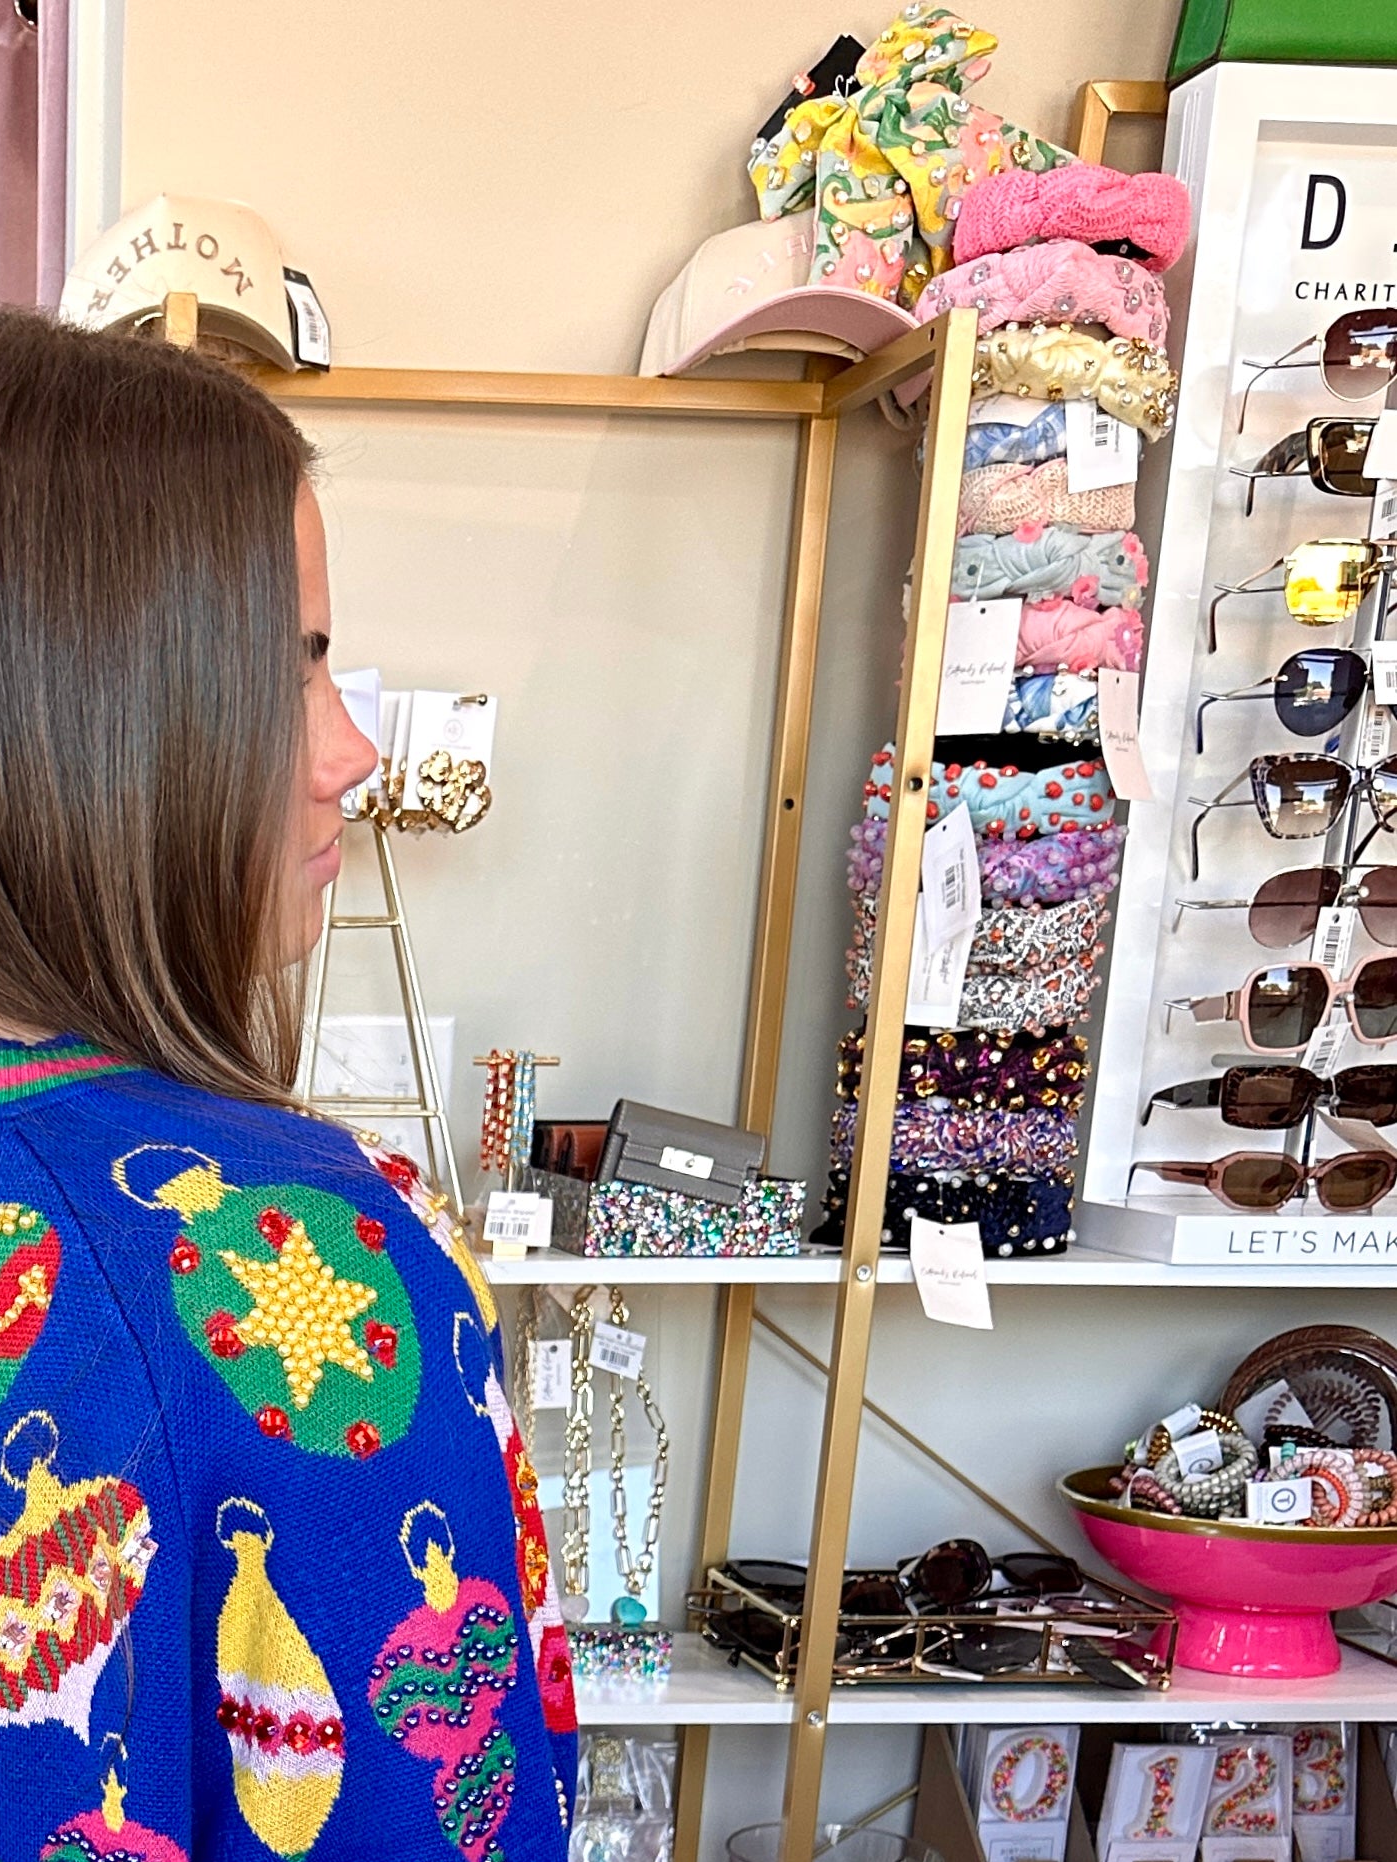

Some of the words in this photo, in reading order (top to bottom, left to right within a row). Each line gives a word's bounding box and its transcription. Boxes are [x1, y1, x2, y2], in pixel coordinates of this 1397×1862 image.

[87, 222, 254, 313] MOTHER
[1295, 281, 1396, 302] CHARIT
[1228, 1230, 1318, 1254] LET'S
